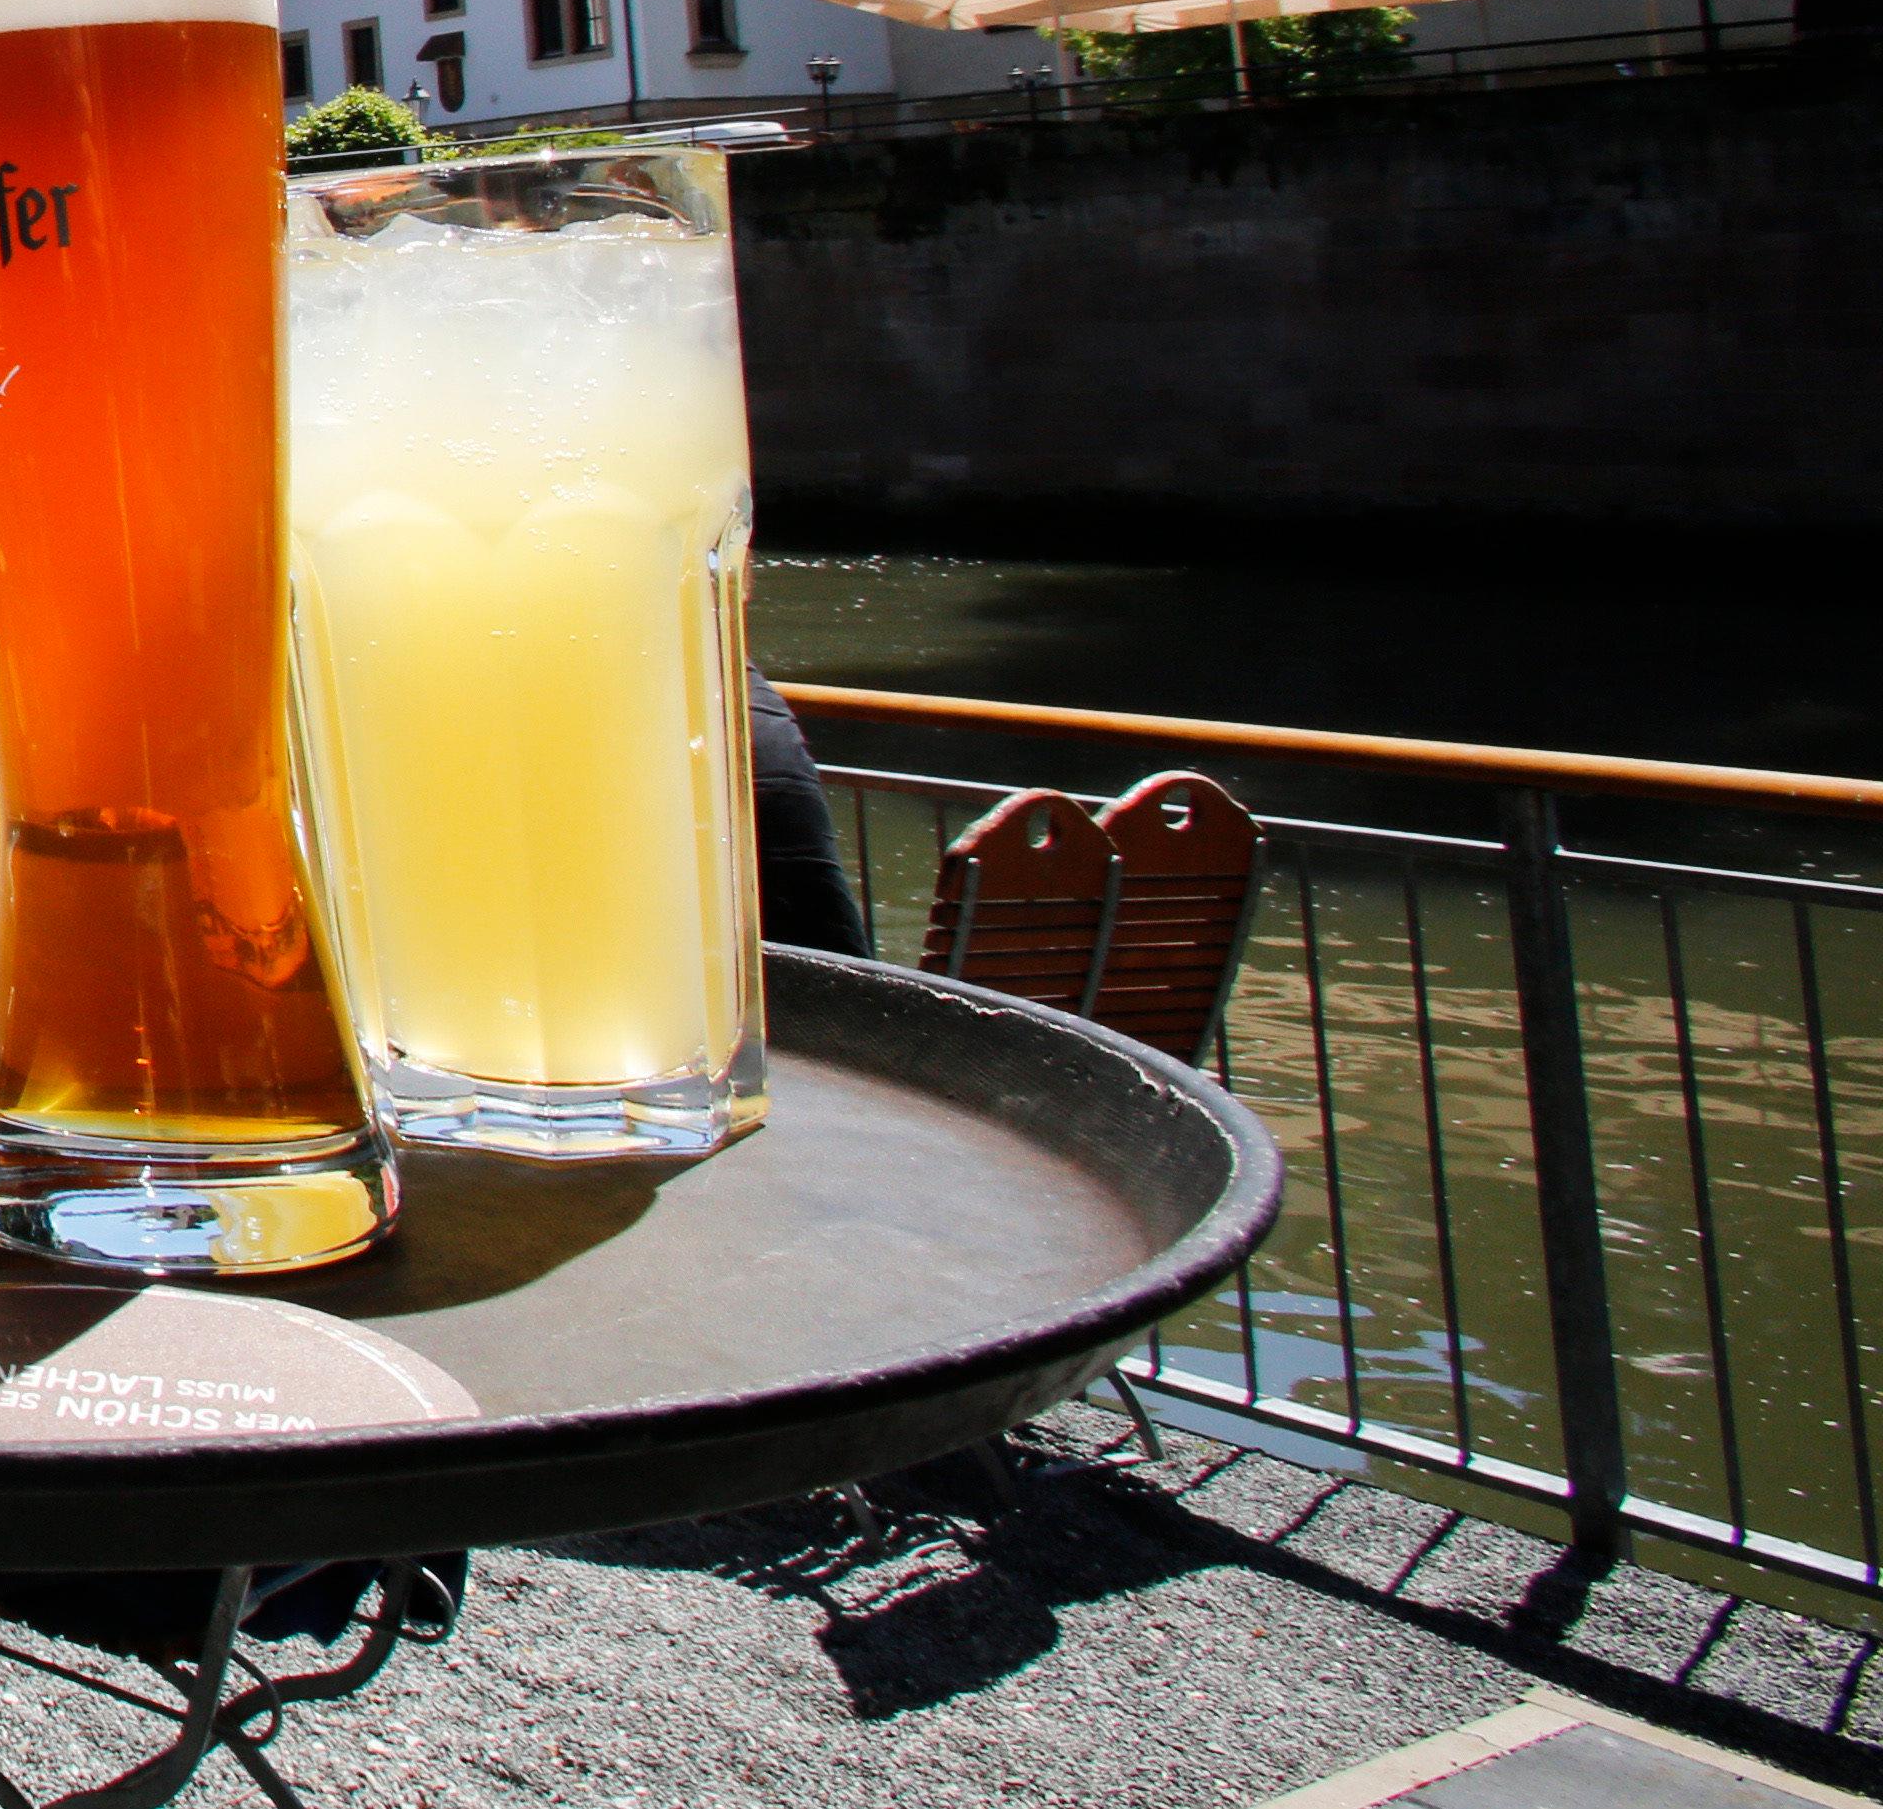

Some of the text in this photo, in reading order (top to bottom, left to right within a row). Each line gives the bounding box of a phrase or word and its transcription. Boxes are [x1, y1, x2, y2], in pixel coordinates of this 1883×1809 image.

[175, 1378, 276, 1404] MUSS
[55, 1395, 223, 1431] SCHÖN
[235, 1410, 317, 1431] WER
